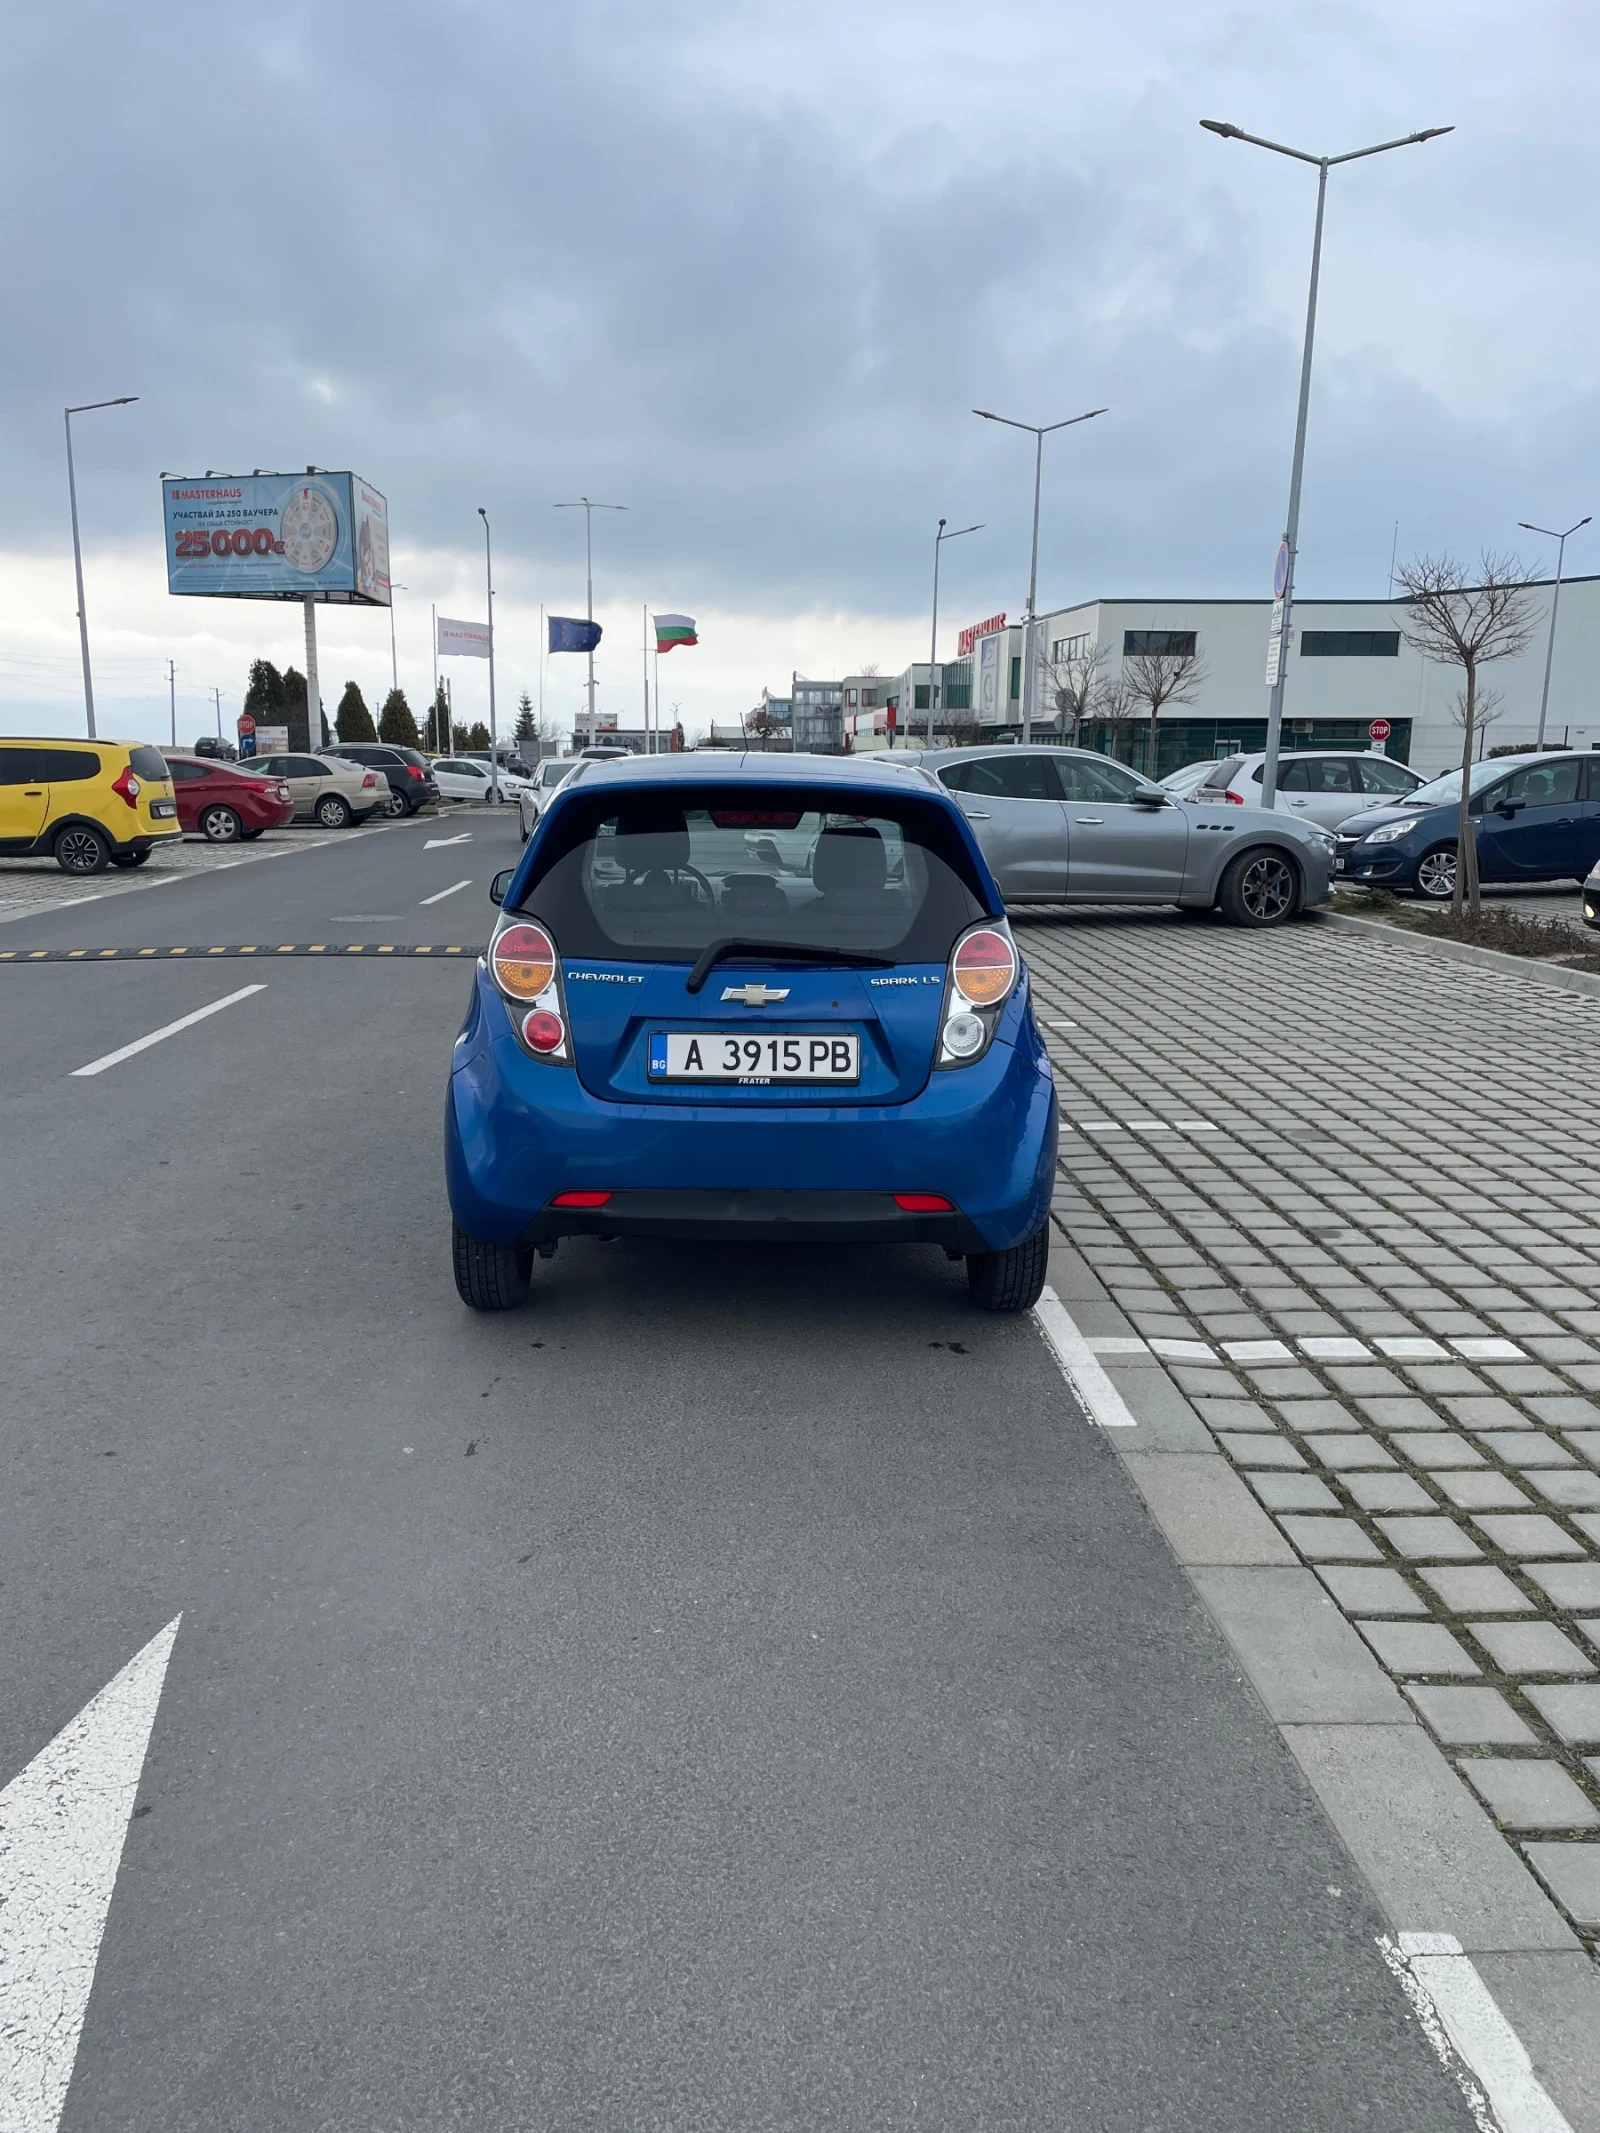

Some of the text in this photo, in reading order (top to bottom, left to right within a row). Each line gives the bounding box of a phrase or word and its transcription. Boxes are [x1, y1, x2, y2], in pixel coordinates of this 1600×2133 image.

[181, 488, 242, 500] MASTERHAUS
[173, 507, 279, 520] УЧАСТВАЙ ЗА 250 ВАУЧЕРА
[224, 519, 253, 527] СТОЙНОСТ
[238, 720, 254, 729] STOP
[1371, 726, 1389, 735] STOP
[567, 972, 645, 984] CHEVROLET
[870, 975, 941, 986] SPARK LS
[652, 1059, 666, 1070] BG
[738, 1077, 771, 1085] FRATER
